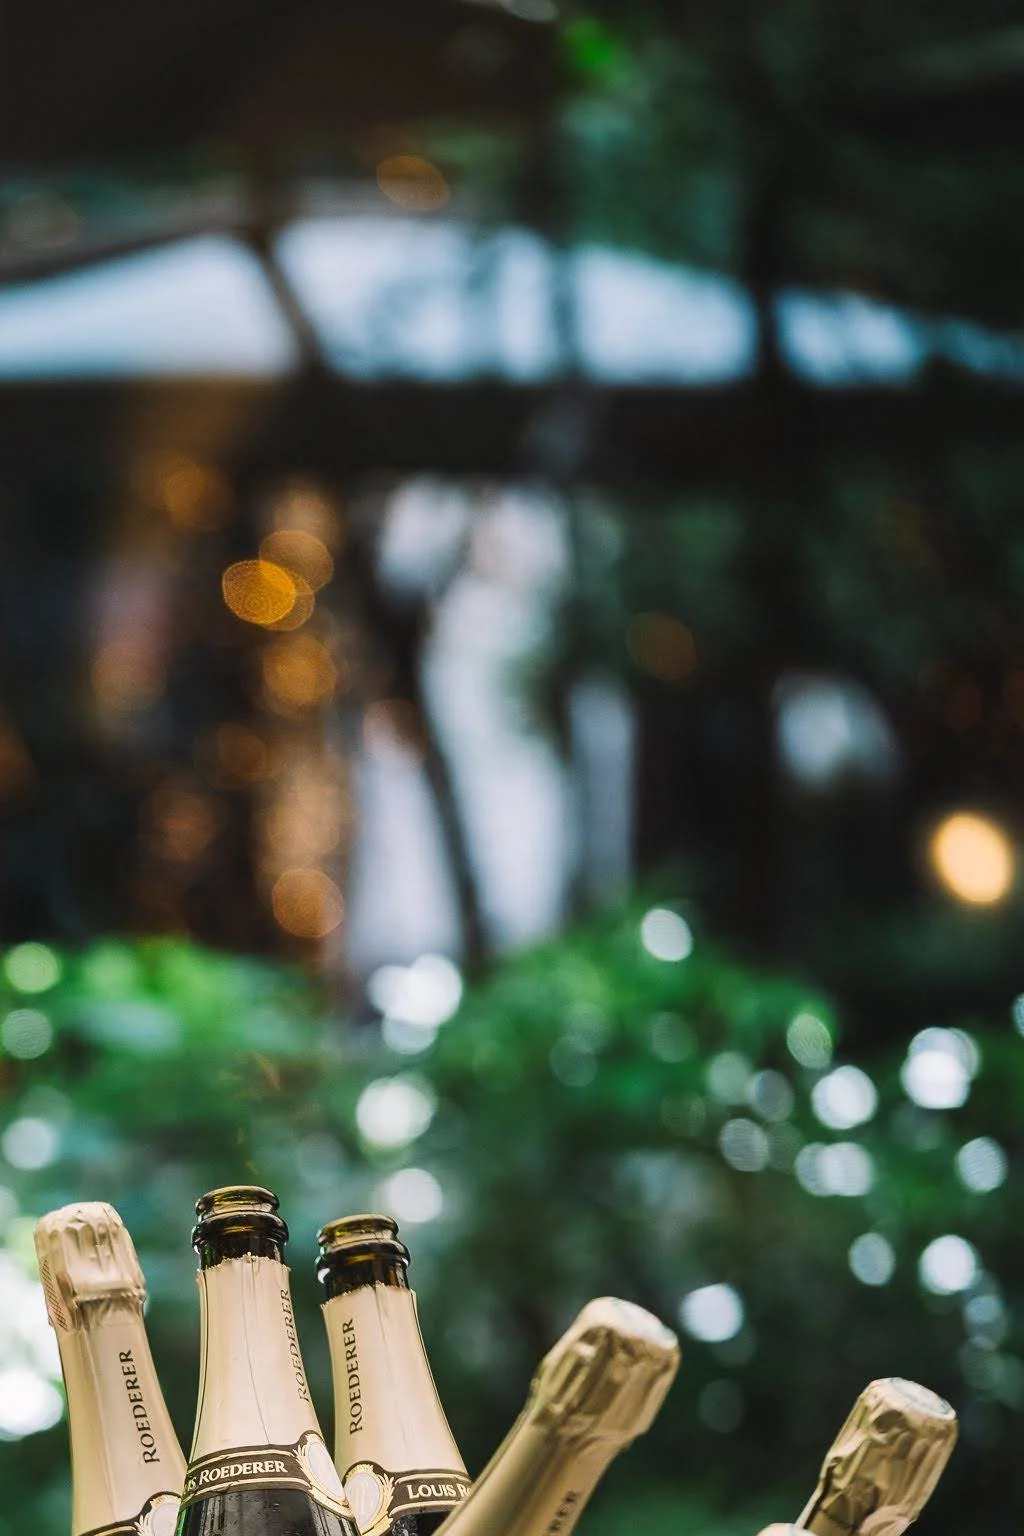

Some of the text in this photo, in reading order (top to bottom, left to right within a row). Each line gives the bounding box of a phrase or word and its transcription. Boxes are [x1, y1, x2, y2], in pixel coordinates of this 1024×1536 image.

[280, 1288, 310, 1402] ROEDERER
[342, 1317, 363, 1436] ROEDERER
[119, 1348, 161, 1464] ROEDERER
[198, 1460, 288, 1486] ROEDERER
[406, 1483, 457, 1499] LOUIS
